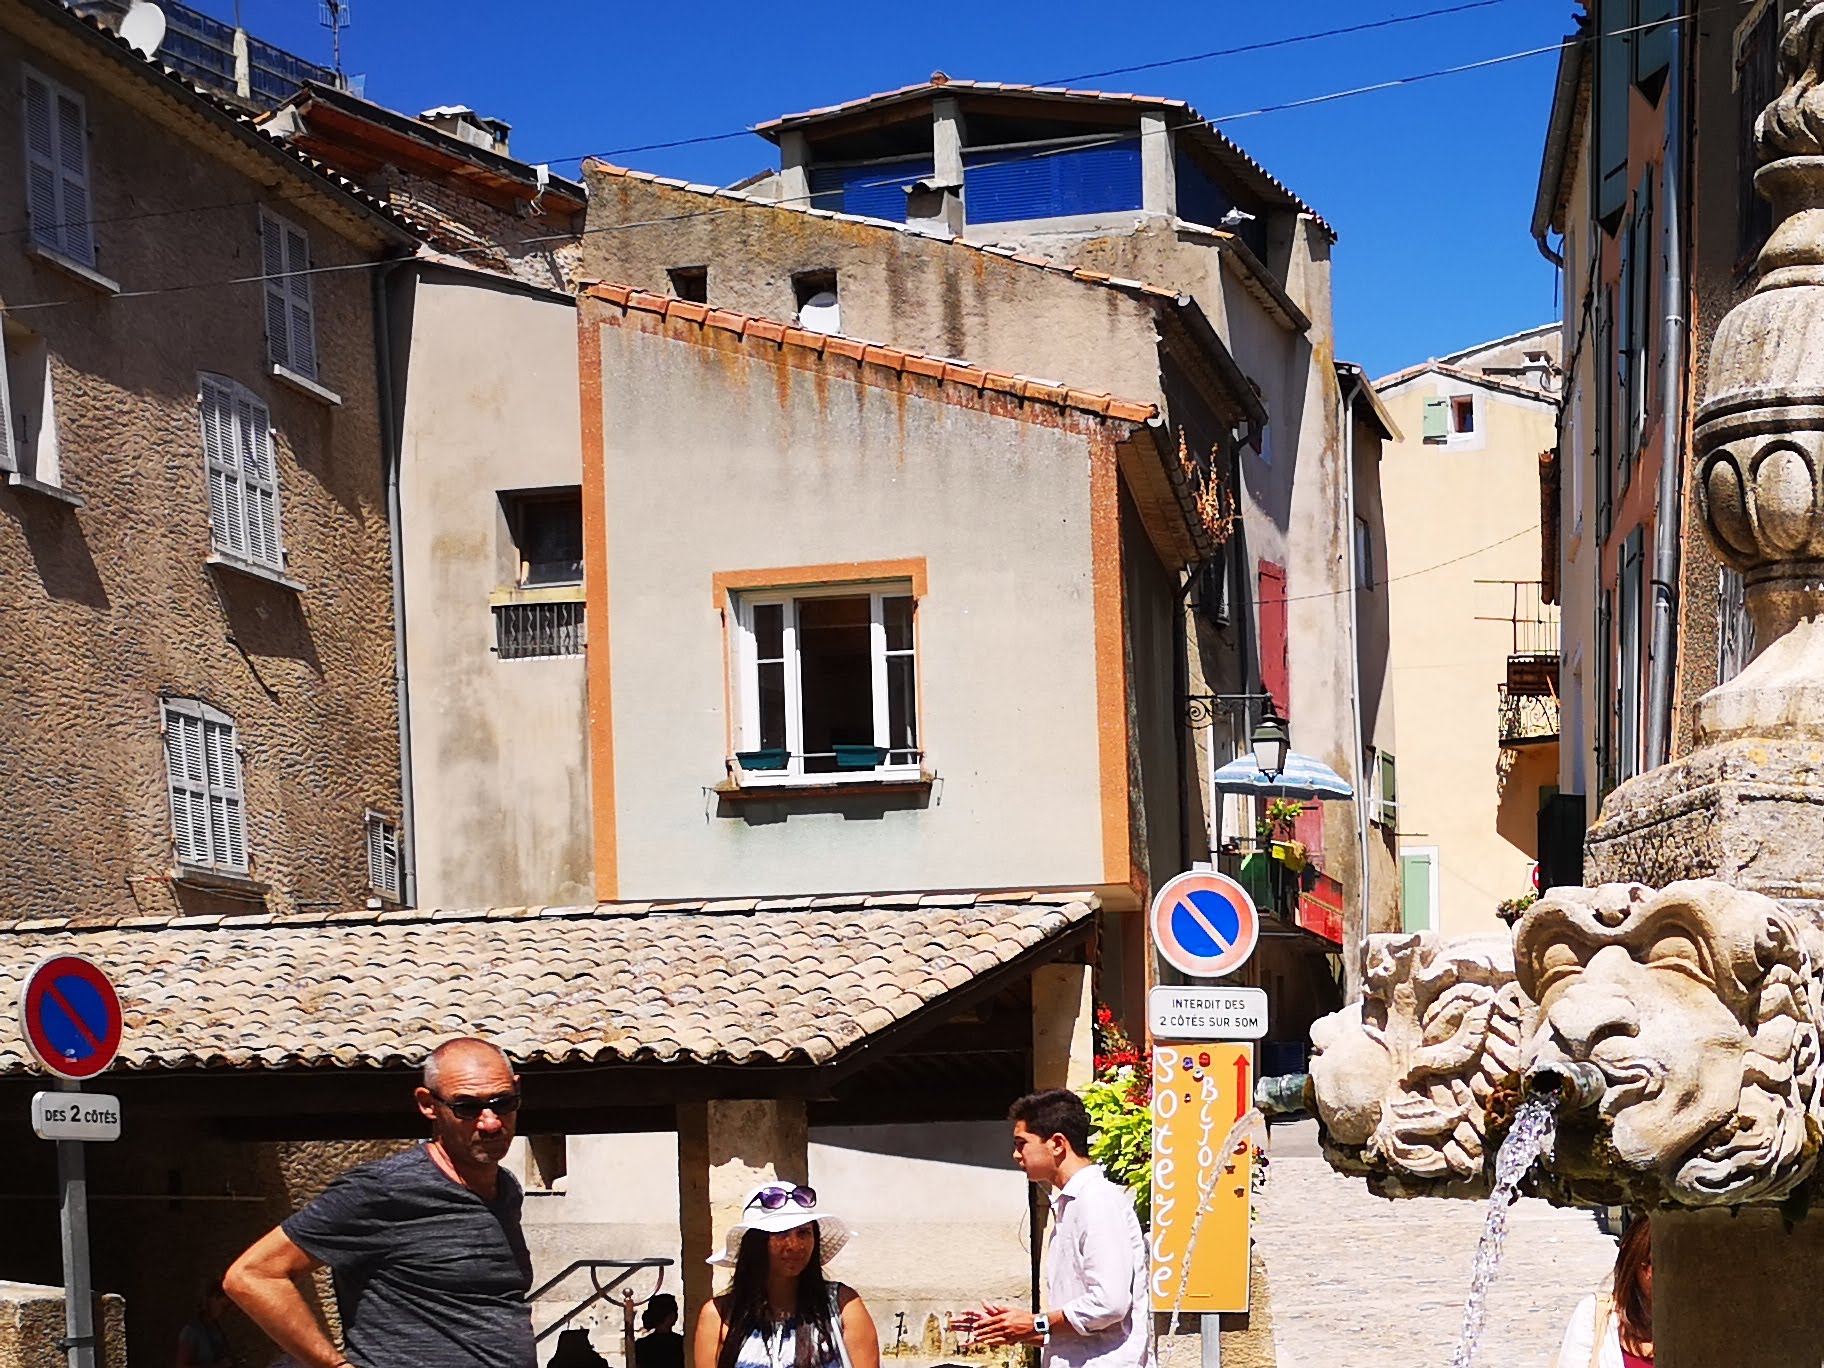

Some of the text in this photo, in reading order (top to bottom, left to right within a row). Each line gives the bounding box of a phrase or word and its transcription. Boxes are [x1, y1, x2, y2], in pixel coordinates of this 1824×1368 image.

[1172, 998, 1246, 1010] INTERDIT DES
[1159, 1014, 1258, 1028] 2 CÔTÉS SUR 50M
[45, 1104, 117, 1124] DES 2 CÔTÉS
